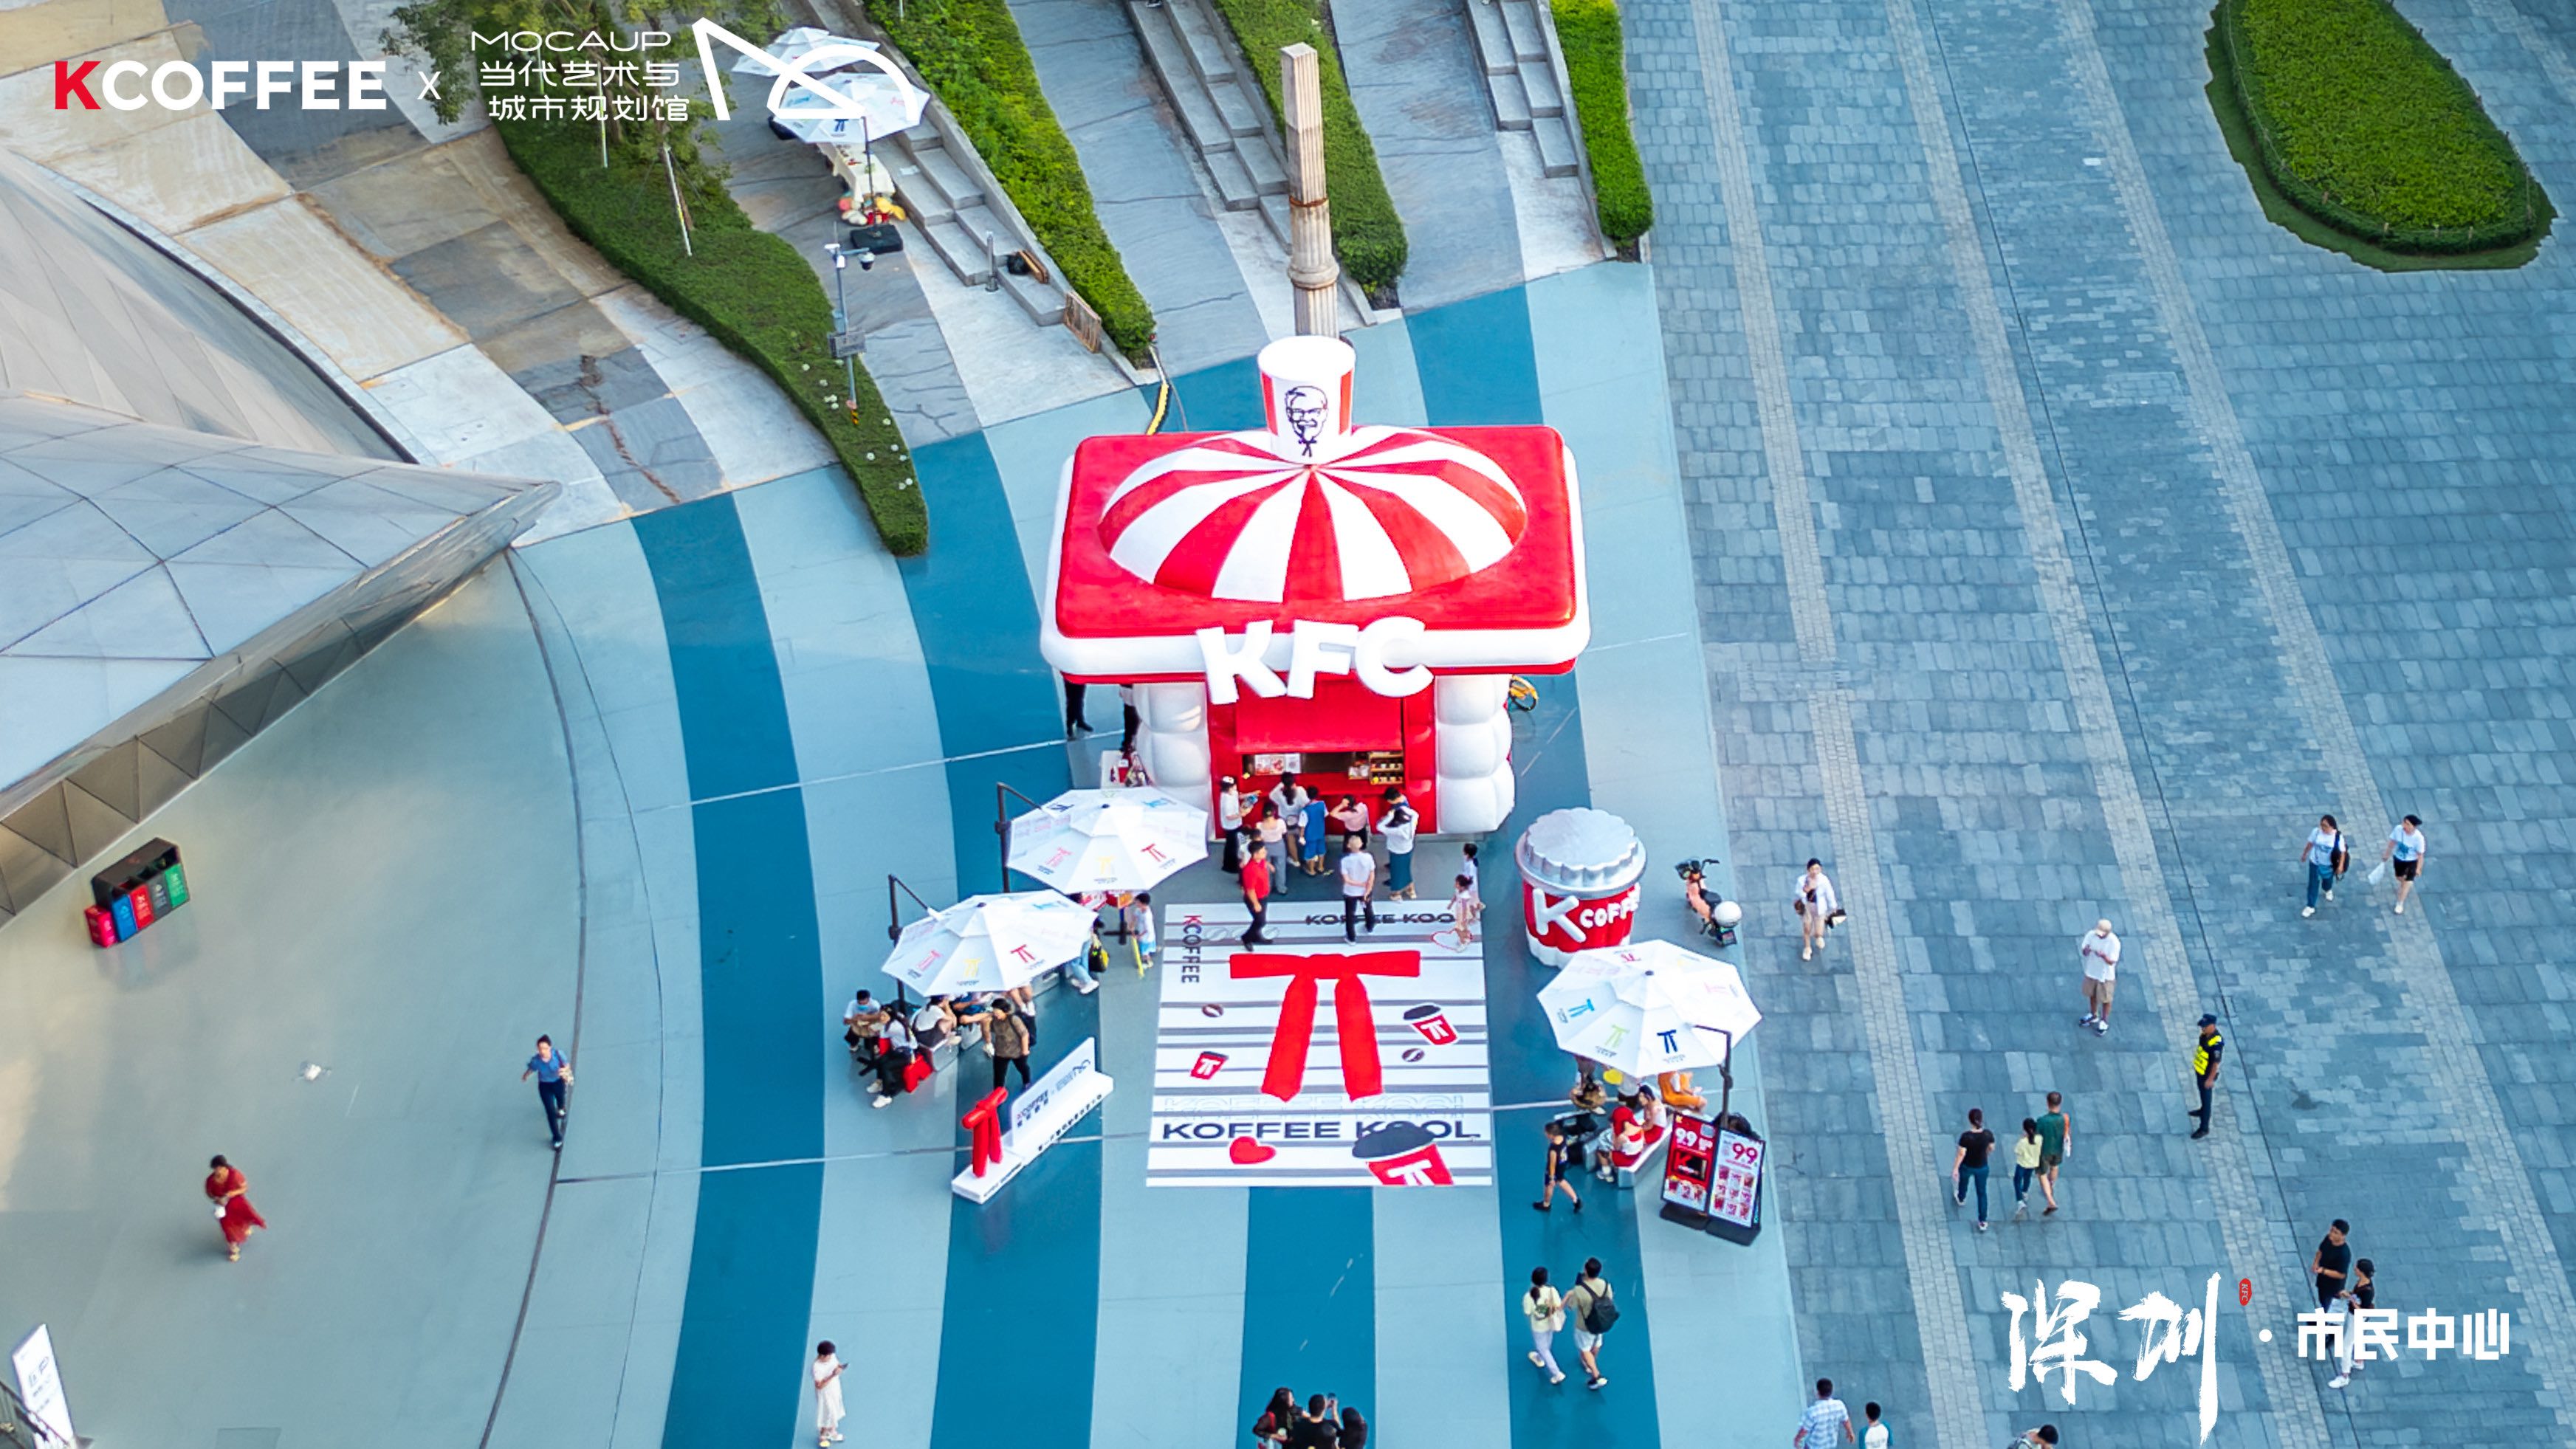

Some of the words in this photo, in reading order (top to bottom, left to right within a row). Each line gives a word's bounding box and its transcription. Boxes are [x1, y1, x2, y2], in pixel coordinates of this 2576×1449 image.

[1195, 615, 1435, 705] KFC
[1403, 913, 1456, 923] KOO
[1181, 915, 1203, 983] KCOFFEE
[1163, 1122, 1340, 1139] KOFFEE
[1356, 1120, 1481, 1138] KOL
